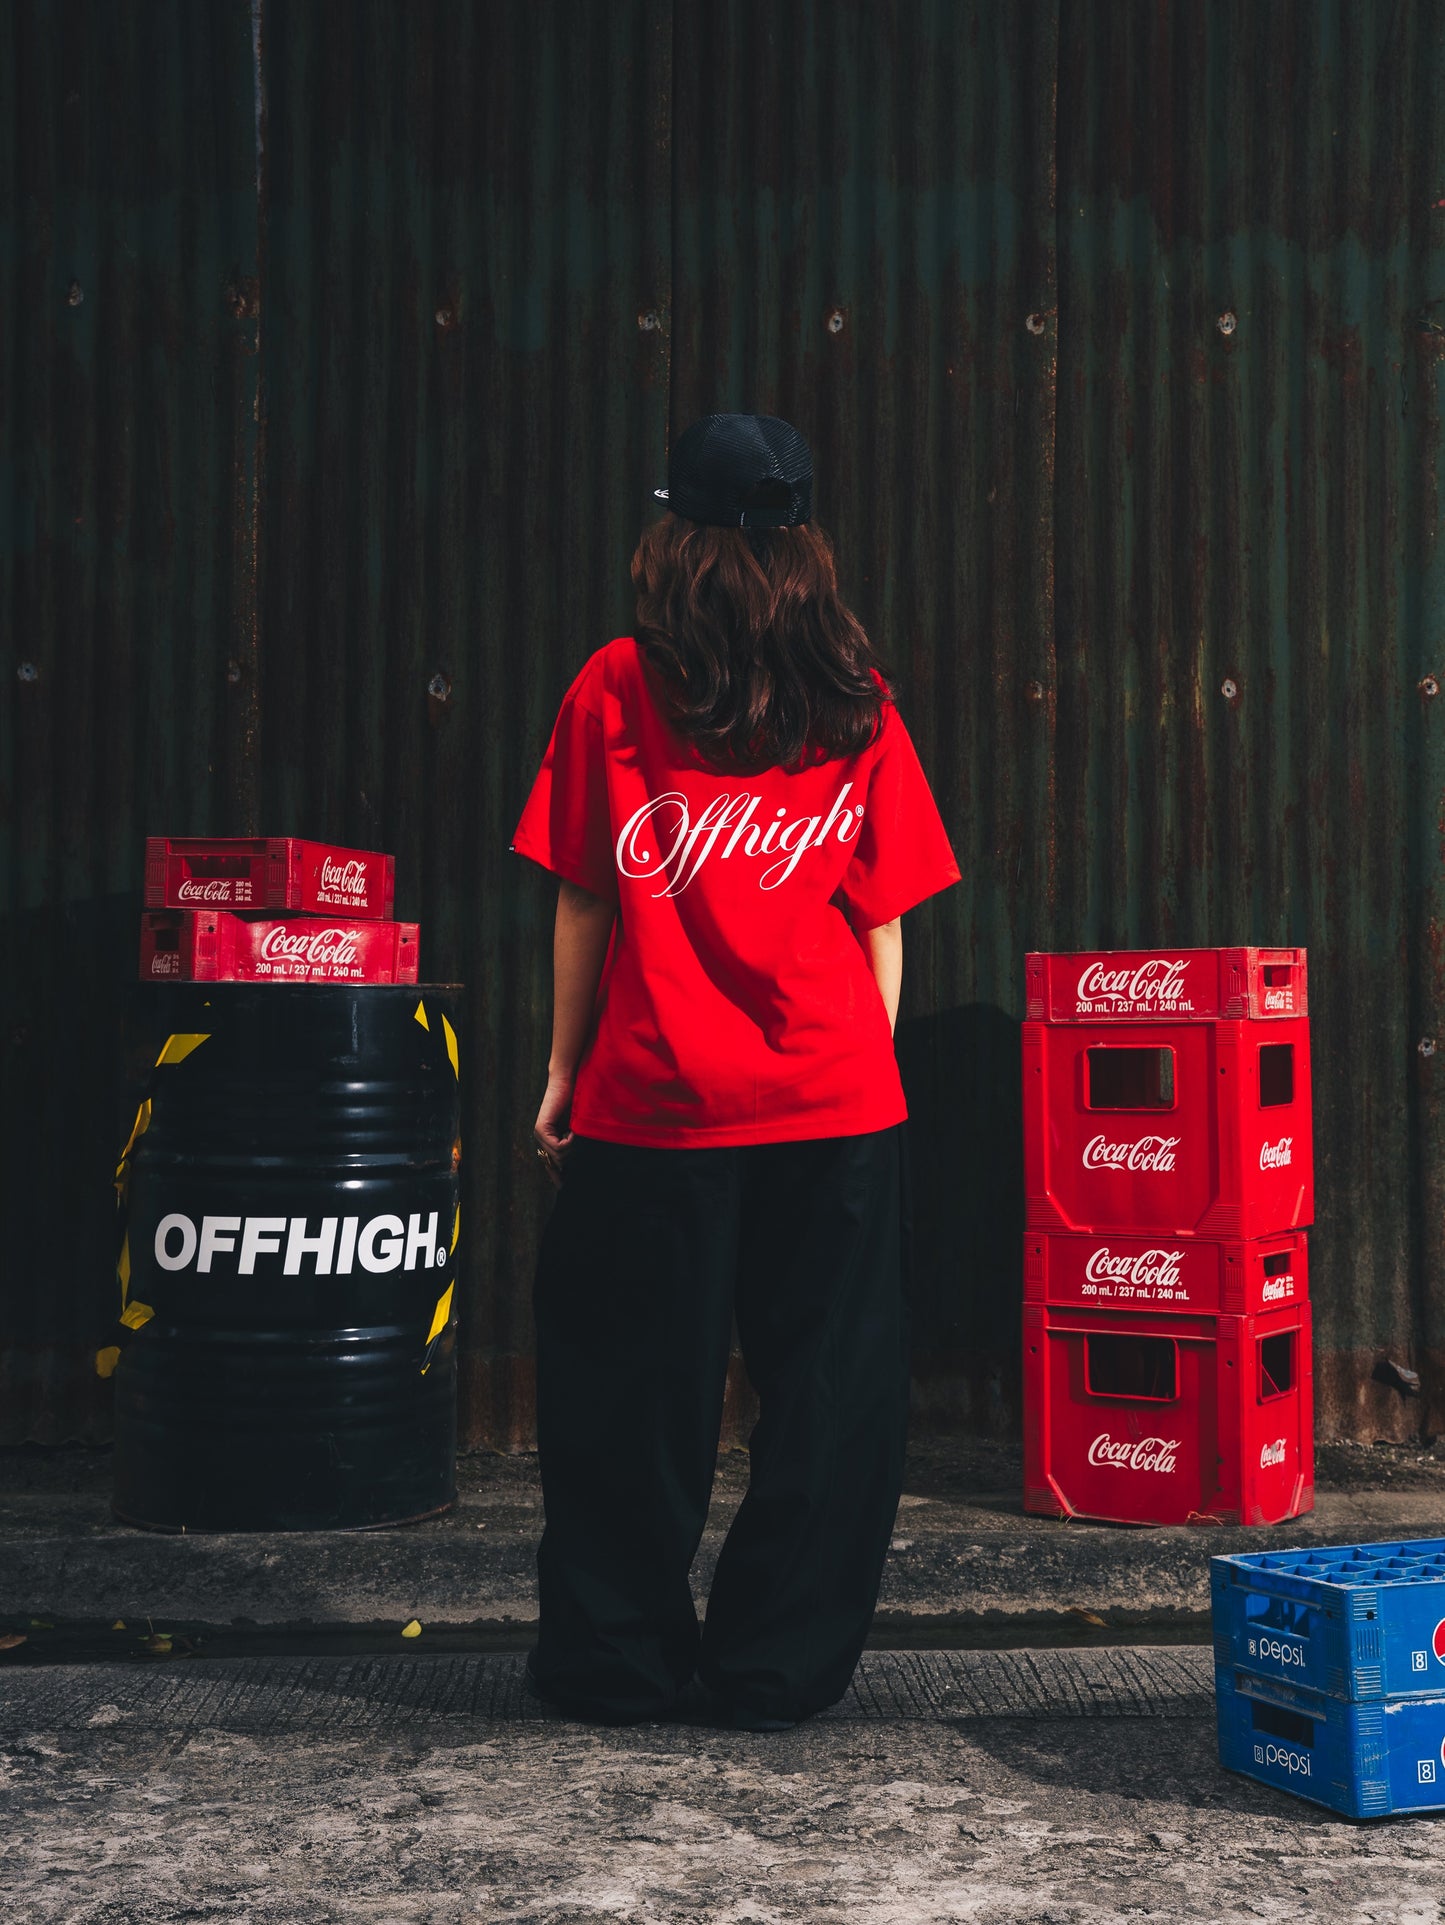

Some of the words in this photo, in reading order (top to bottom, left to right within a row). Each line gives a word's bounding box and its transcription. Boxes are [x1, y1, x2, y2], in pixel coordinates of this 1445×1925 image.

[178, 880, 231, 901] Coca-Cola
[321, 856, 367, 895] Coca-Cola
[261, 926, 362, 964] Coca-Cola
[256, 963, 271, 974] 200
[273, 964, 287, 974] mL
[294, 964, 310, 975] 237
[312, 966, 326, 976] mL
[333, 966, 348, 976] 240
[350, 968, 364, 977] mL
[1077, 960, 1191, 1001] Coca-Cola
[1076, 1001, 1092, 1012] 200
[1095, 1001, 1110, 1012] mL
[1118, 1000, 1134, 1012] 237
[1136, 1000, 1152, 1012] mL
[1160, 1000, 1176, 1011] 240
[1179, 1000, 1194, 1011] mL
[1082, 1135, 1181, 1172] Coca-Cola
[1260, 1137, 1293, 1170] Coca-Cola
[1085, 1248, 1185, 1286] Coca-Cola
[1082, 1284, 1097, 1294] 200
[1099, 1286, 1112, 1296] mL
[1119, 1286, 1134, 1297] 237
[1136, 1288, 1150, 1298] mL
[1158, 1289, 1173, 1299] 240
[1176, 1290, 1190, 1300] mL
[1088, 1434, 1181, 1473] Coca-Cola
[1260, 1638, 1303, 1666] pepsi
[1416, 1653, 1424, 1669] 8
[1266, 1744, 1310, 1776] pepsi
[1422, 1764, 1432, 1780] 8
